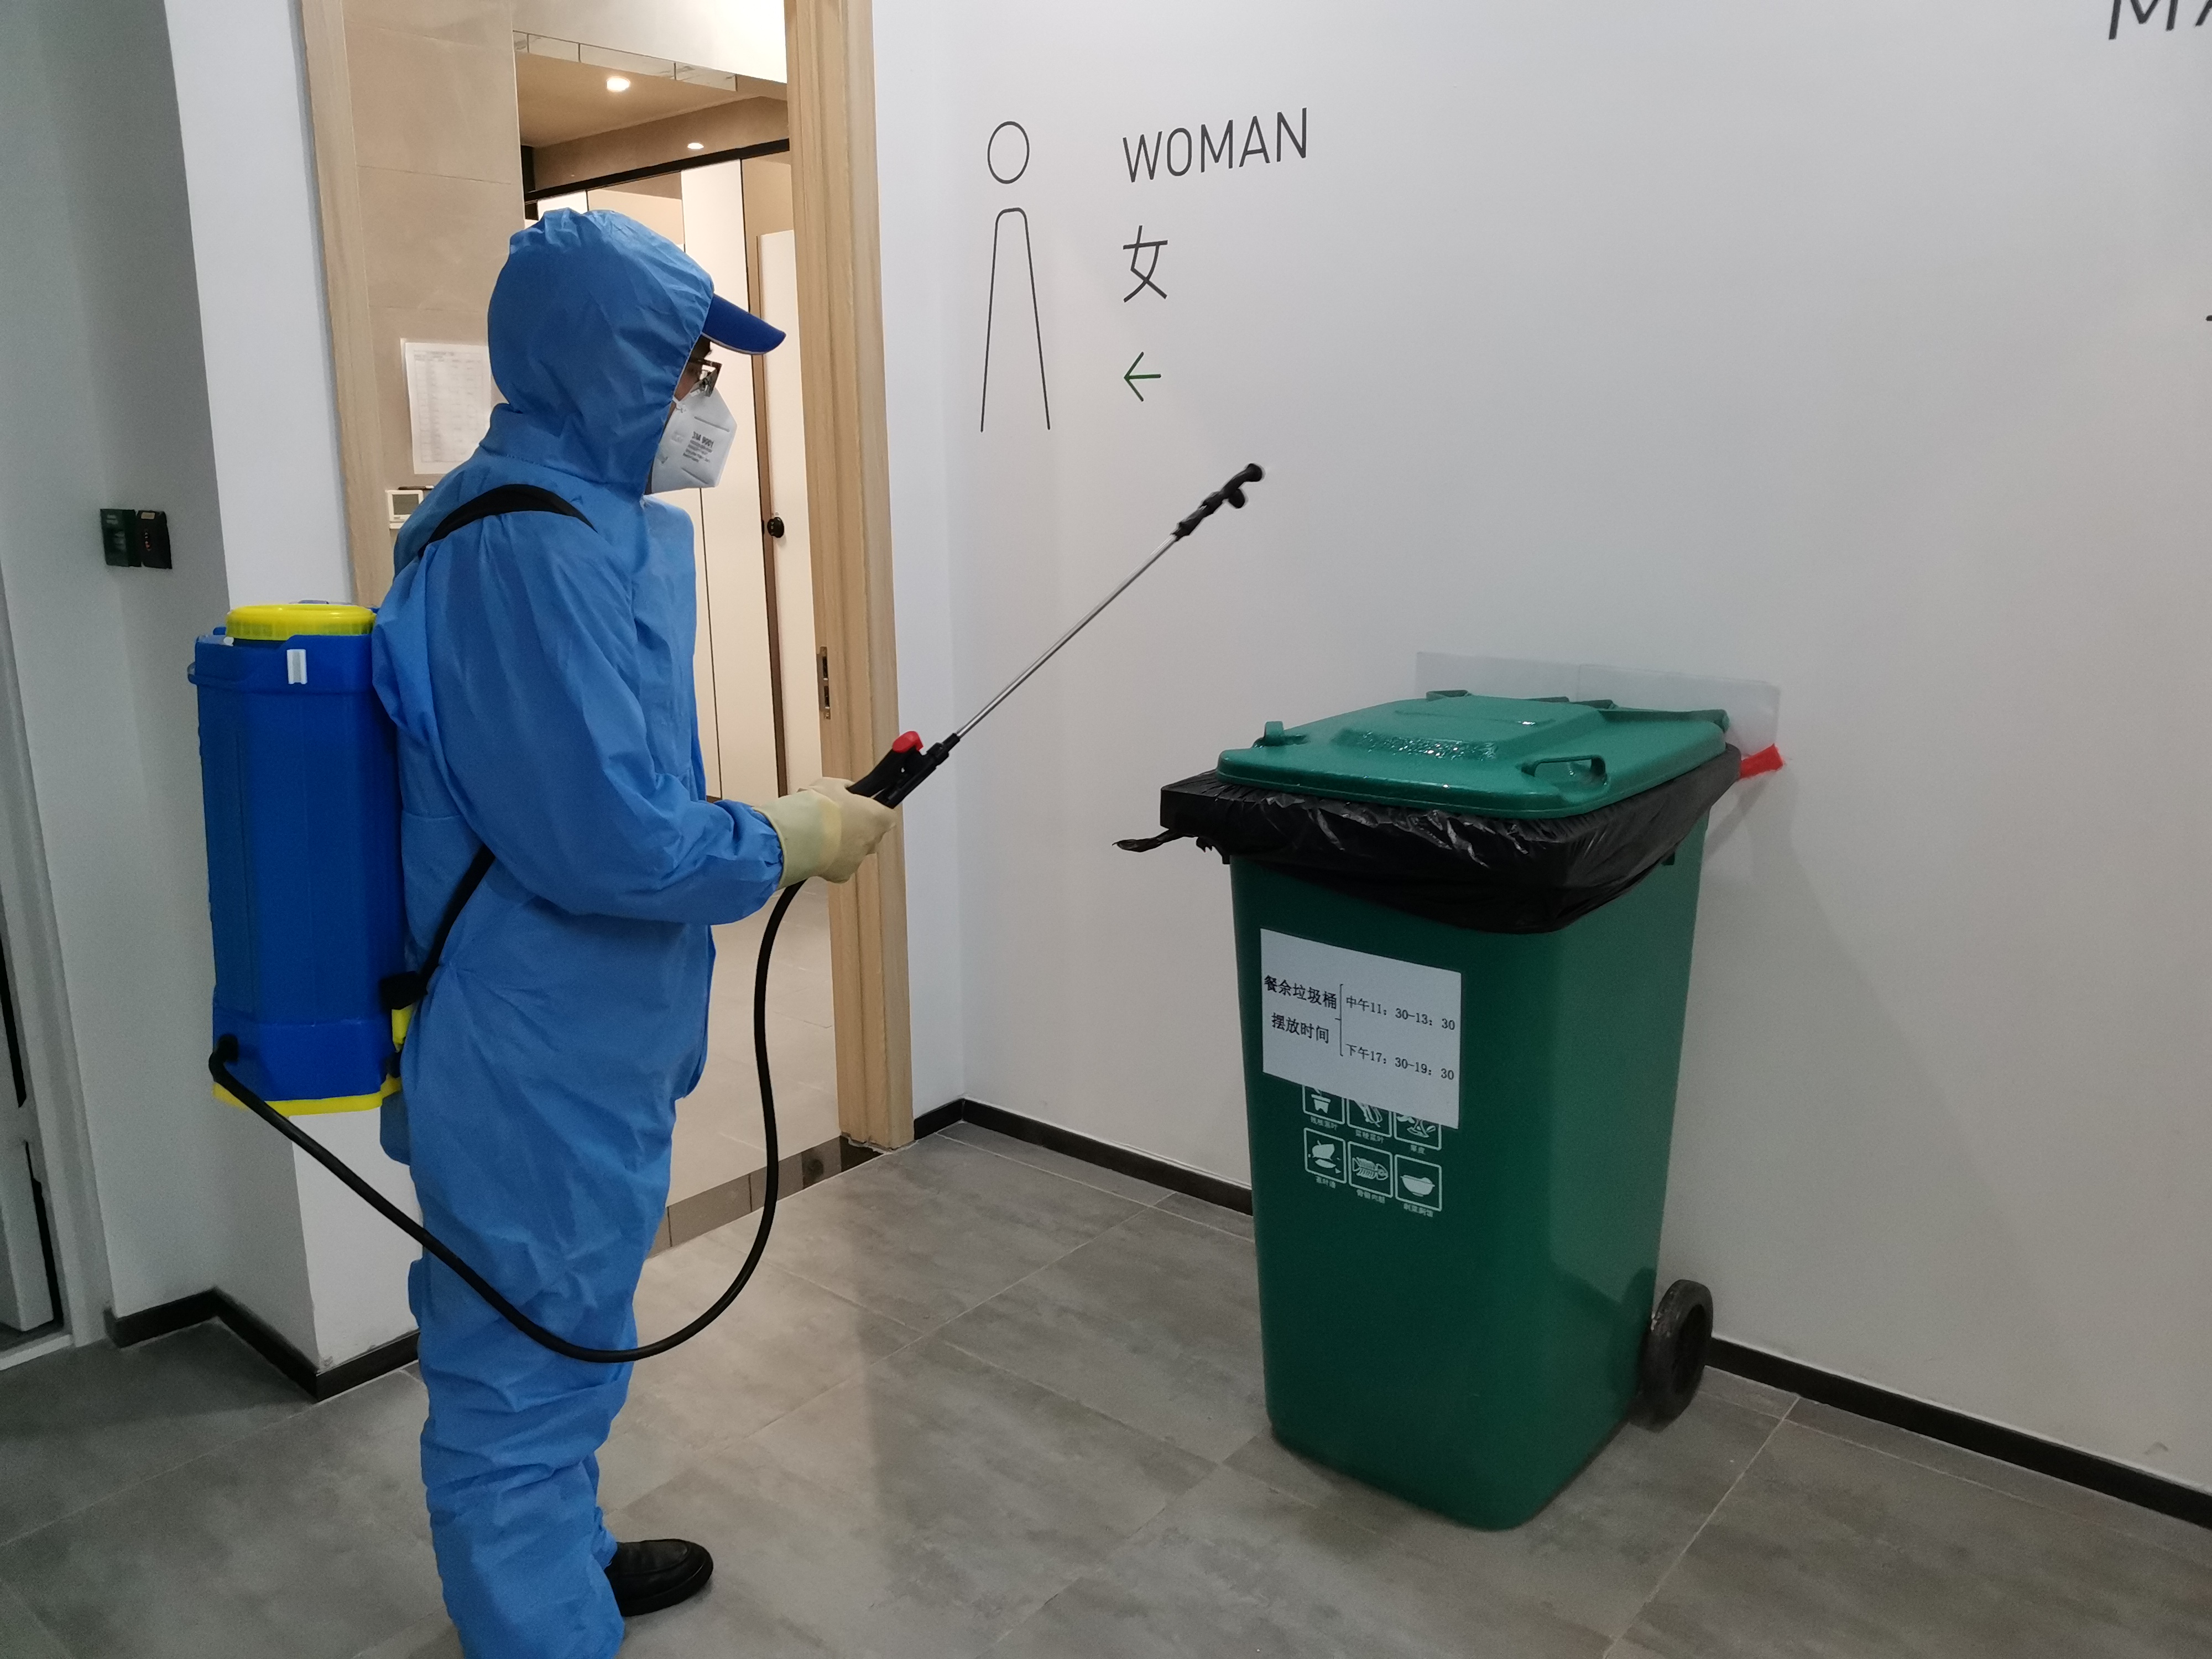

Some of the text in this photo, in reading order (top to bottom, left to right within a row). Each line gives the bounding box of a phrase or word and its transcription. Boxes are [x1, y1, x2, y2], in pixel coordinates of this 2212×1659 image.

[1123, 107, 1307, 182] WOMAN
[1123, 225, 1168, 302] 女
[1264, 975, 1337, 1009] 餐余垃圾桶
[1271, 1012, 1329, 1044] 摆放时间
